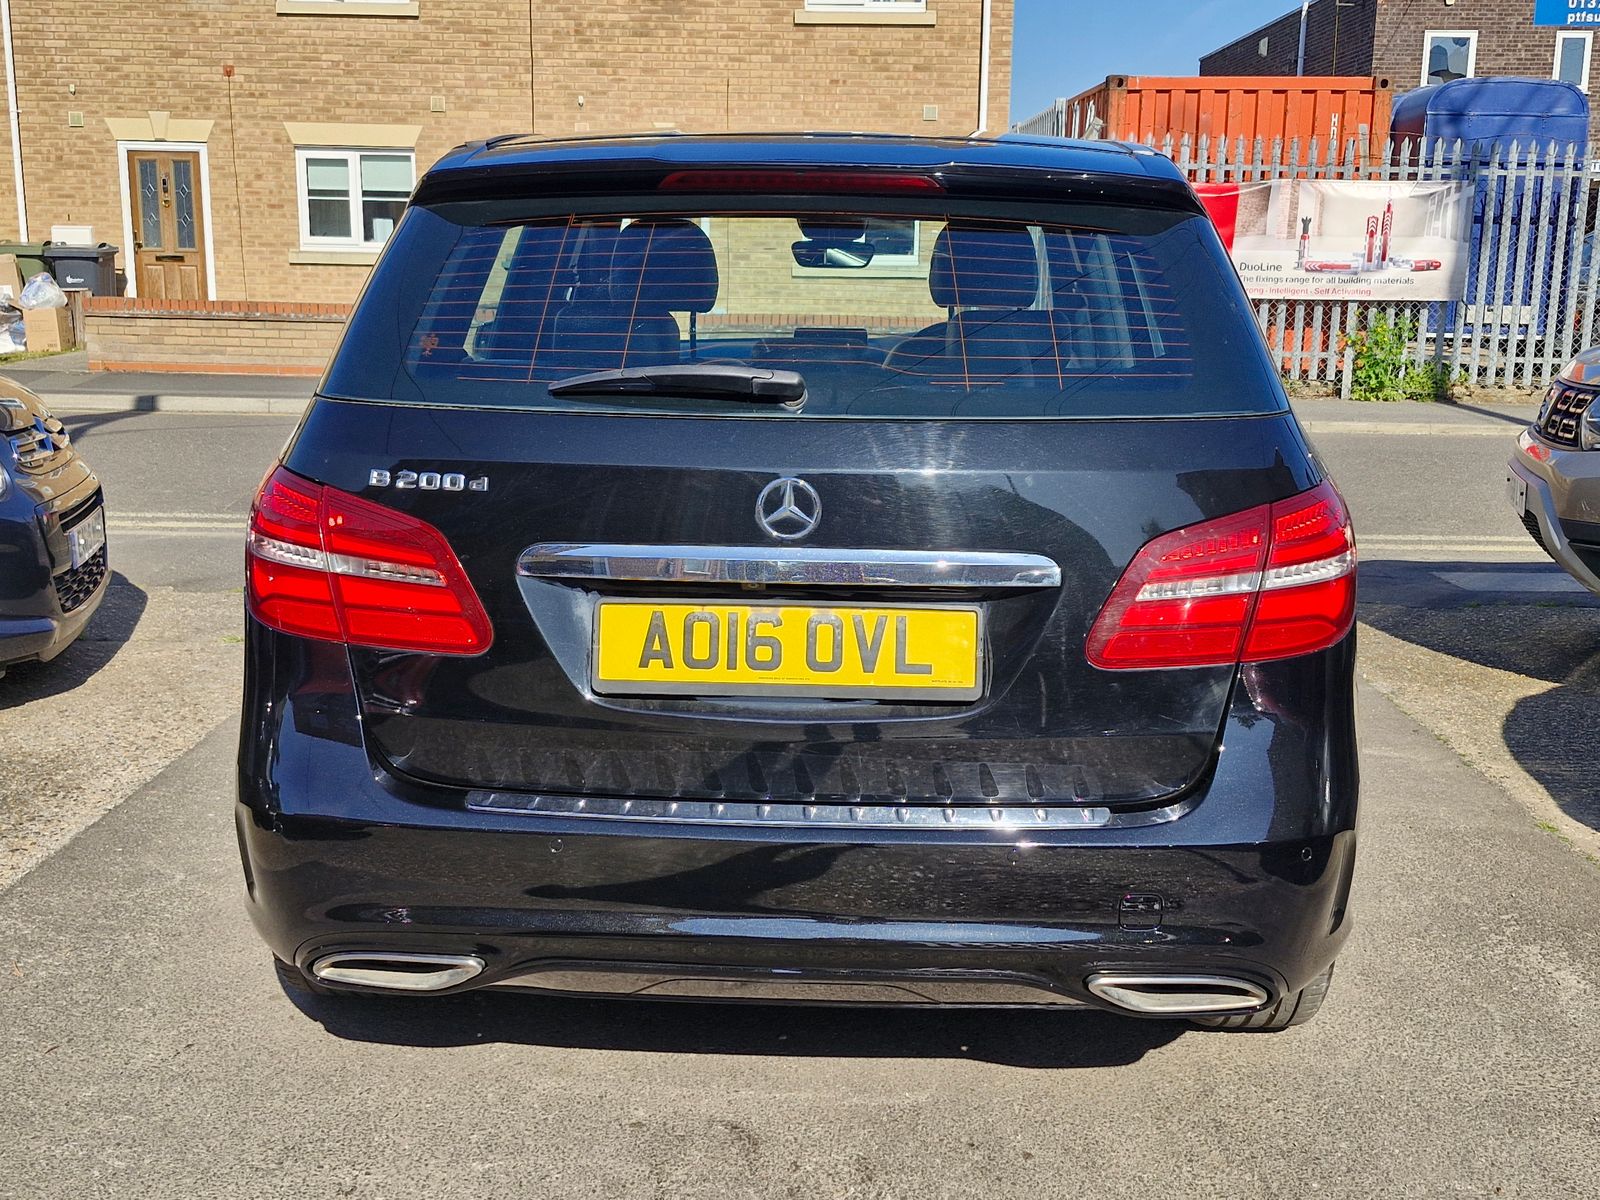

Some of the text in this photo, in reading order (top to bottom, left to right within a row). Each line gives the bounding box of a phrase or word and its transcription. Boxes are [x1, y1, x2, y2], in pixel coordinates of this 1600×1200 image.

[1568, 0, 1600, 8] 013
[1239, 262, 1283, 272] DuoLine
[1255, 275, 1284, 285] fixings
[1285, 276, 1310, 285] range
[1311, 275, 1324, 283] for
[1325, 275, 1336, 284] all
[1337, 276, 1372, 286] building
[1373, 277, 1415, 285] materials
[1269, 287, 1309, 295] Intelligent
[1313, 287, 1330, 295] Self
[1330, 287, 1372, 297] Activating
[638, 610, 933, 675] AO16 OVL
